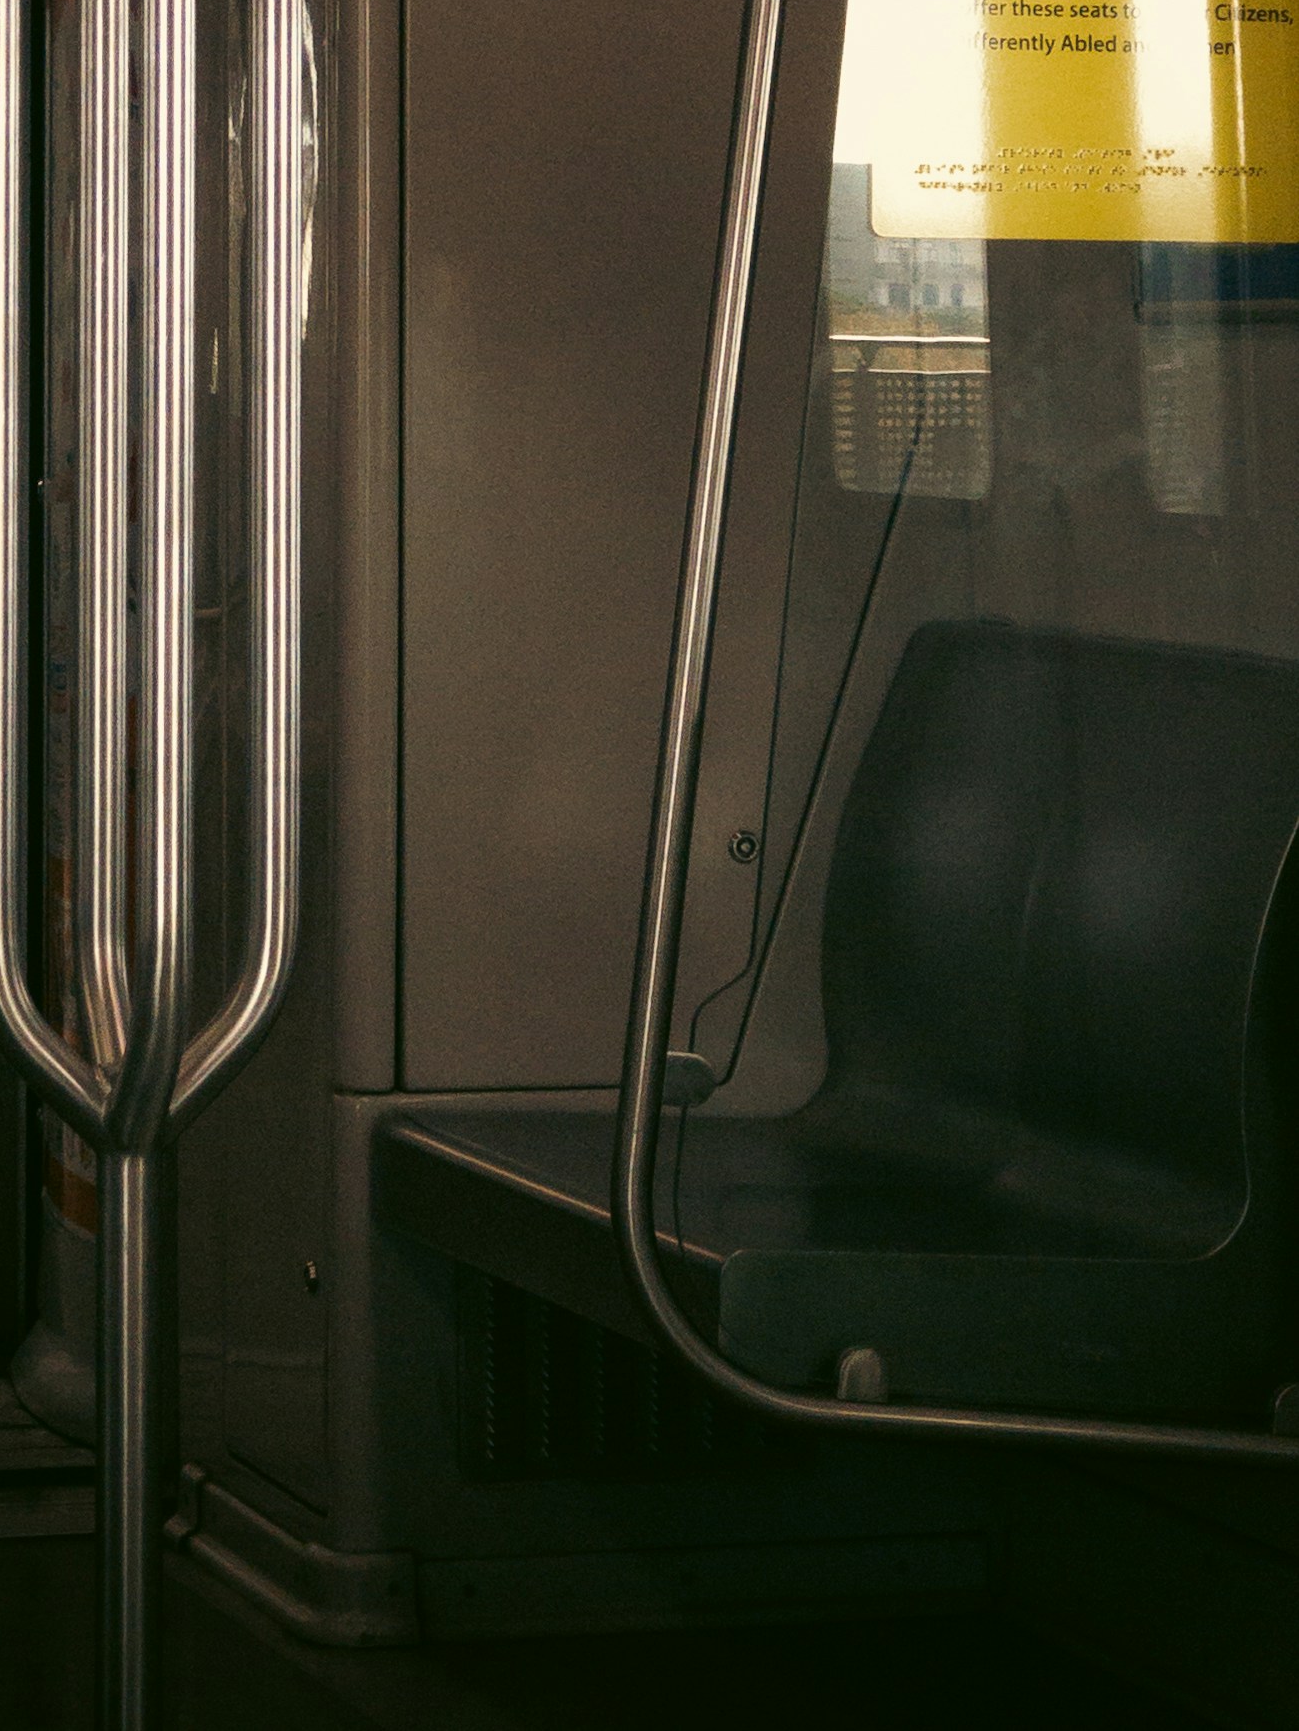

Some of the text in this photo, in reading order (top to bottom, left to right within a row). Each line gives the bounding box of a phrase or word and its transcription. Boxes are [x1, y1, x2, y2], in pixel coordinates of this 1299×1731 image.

[1011, 0, 1064, 18] these
[1069, 1, 1118, 19] seats
[1122, 2, 1143, 20] to
[1060, 34, 1117, 53] Abled
